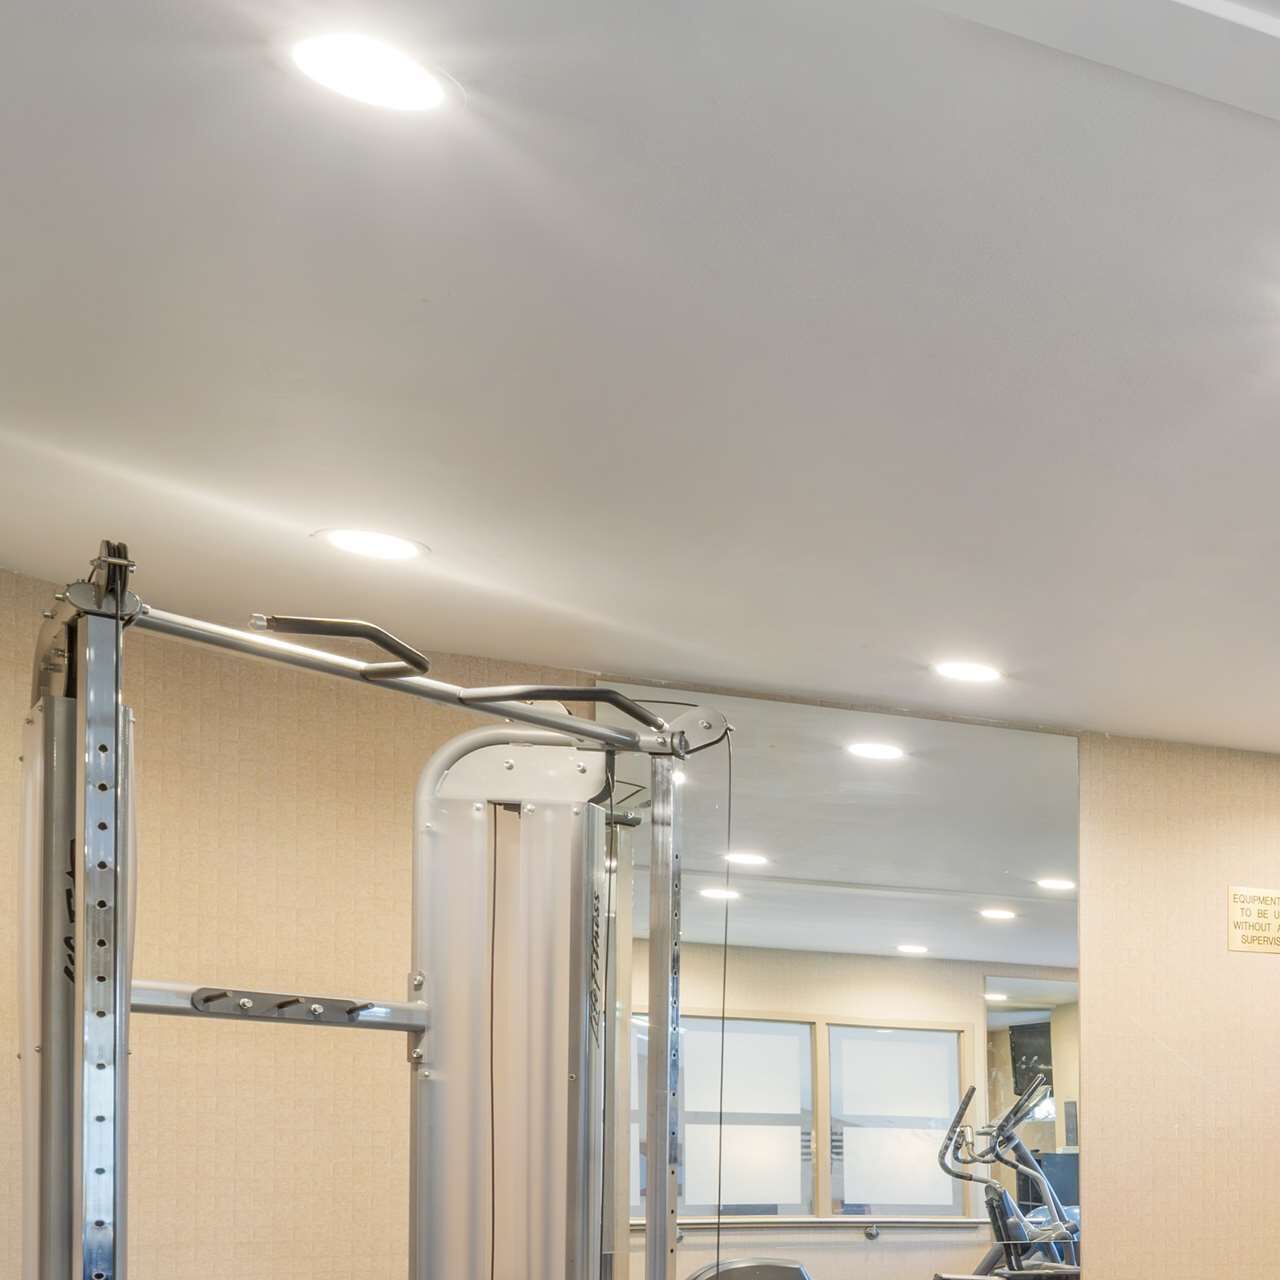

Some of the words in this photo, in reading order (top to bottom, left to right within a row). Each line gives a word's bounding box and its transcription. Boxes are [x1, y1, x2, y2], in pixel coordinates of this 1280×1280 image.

[1232, 893, 1280, 906] EQUIPMENT
[1240, 907, 1252, 918] TO
[1257, 908, 1269, 919] BE
[1233, 921, 1272, 932] WITHOUT
